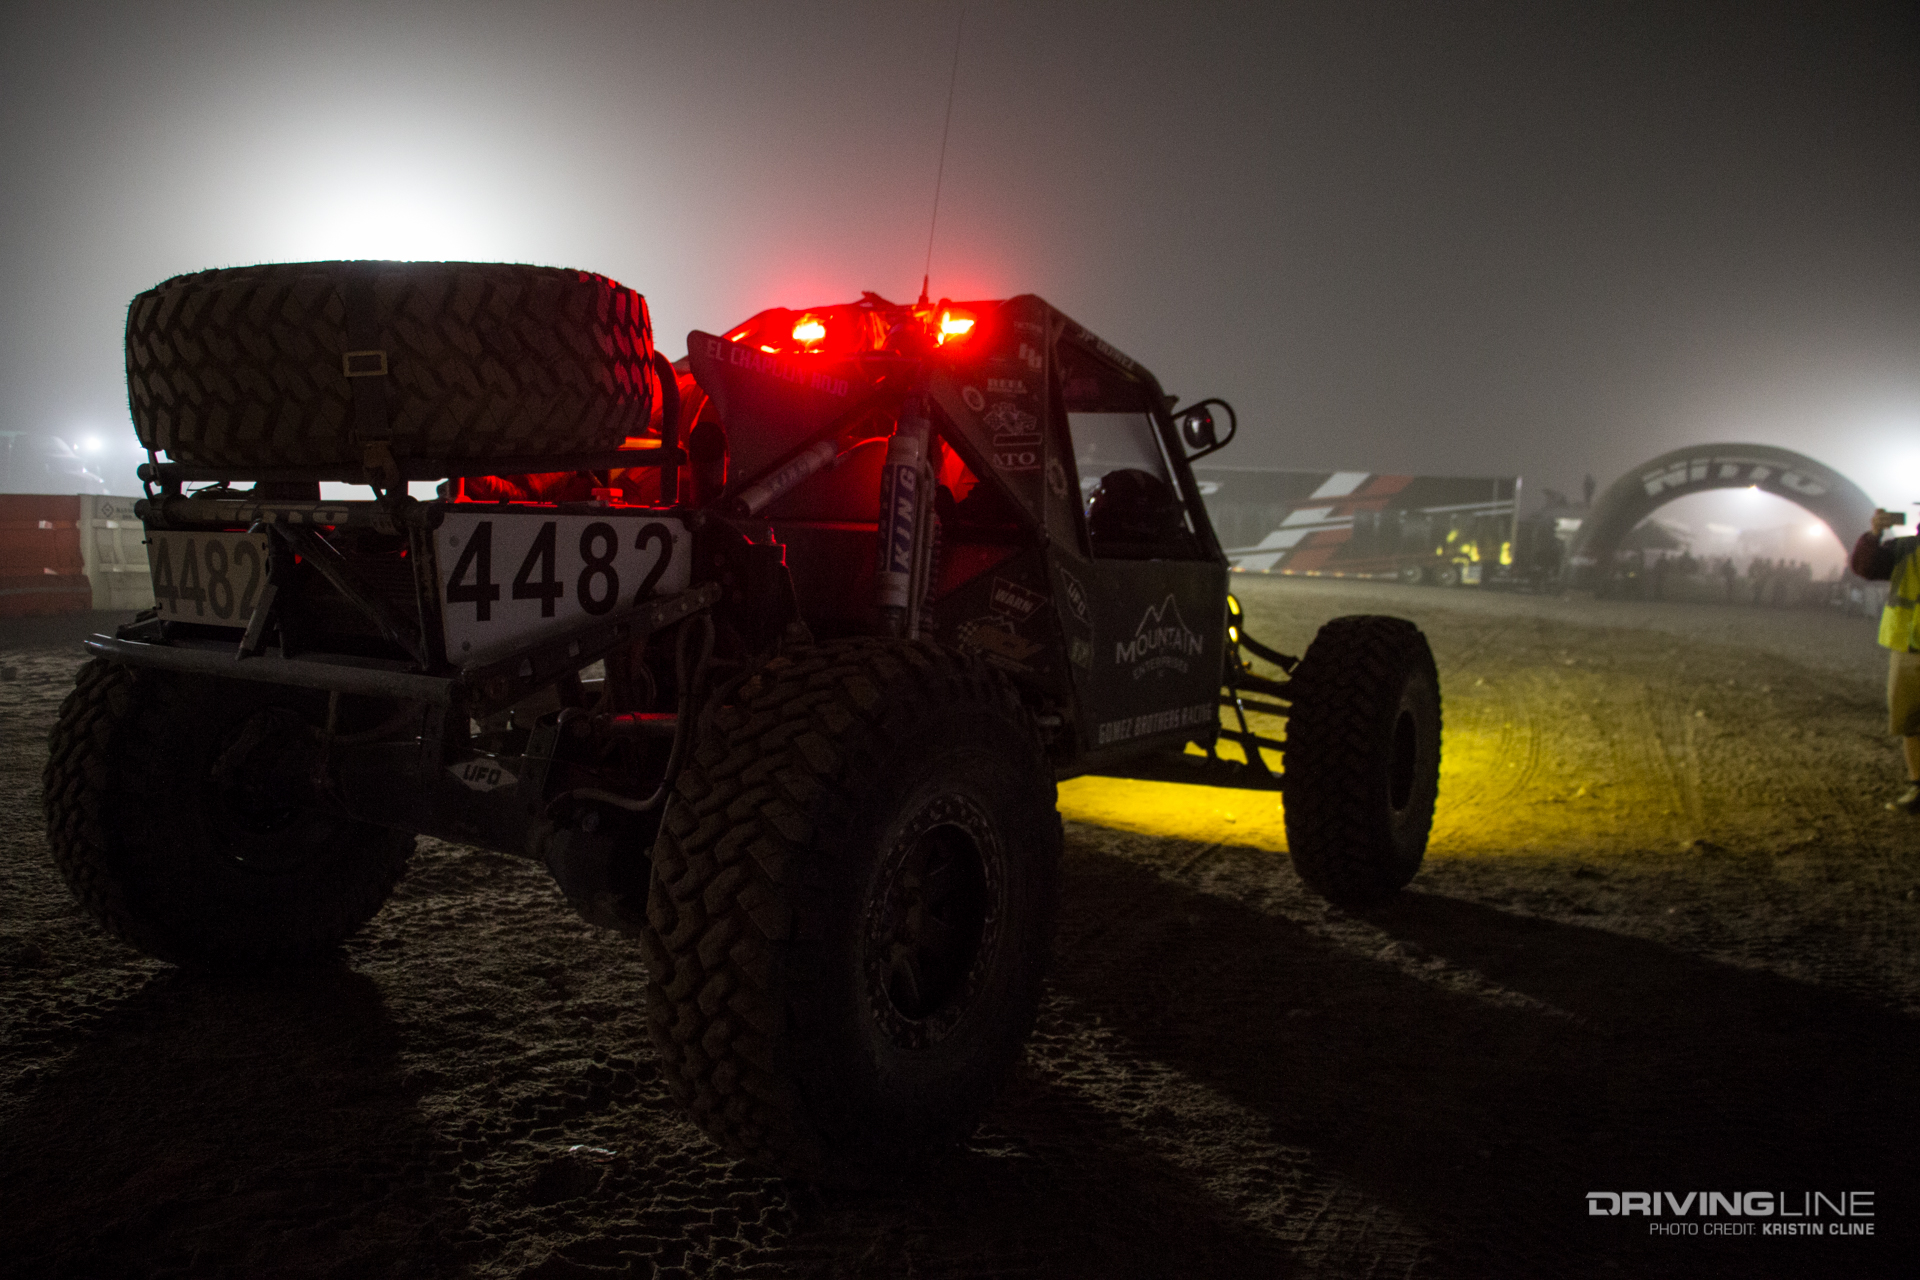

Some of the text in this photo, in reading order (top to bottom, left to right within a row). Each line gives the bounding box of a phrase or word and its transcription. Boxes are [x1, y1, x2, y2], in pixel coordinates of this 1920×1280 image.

[706, 339, 849, 397] EL CHAPULIN ROJO
[894, 467, 916, 569] KING
[152, 536, 261, 621] 4482
[447, 521, 673, 621] 4482
[995, 588, 1034, 613] WARN
[1068, 582, 1086, 616] UFO
[1115, 626, 1204, 665] MOUNTAIN
[1098, 702, 1214, 745] GOMEZ BROTHERS RACING
[468, 765, 502, 791] UFO
